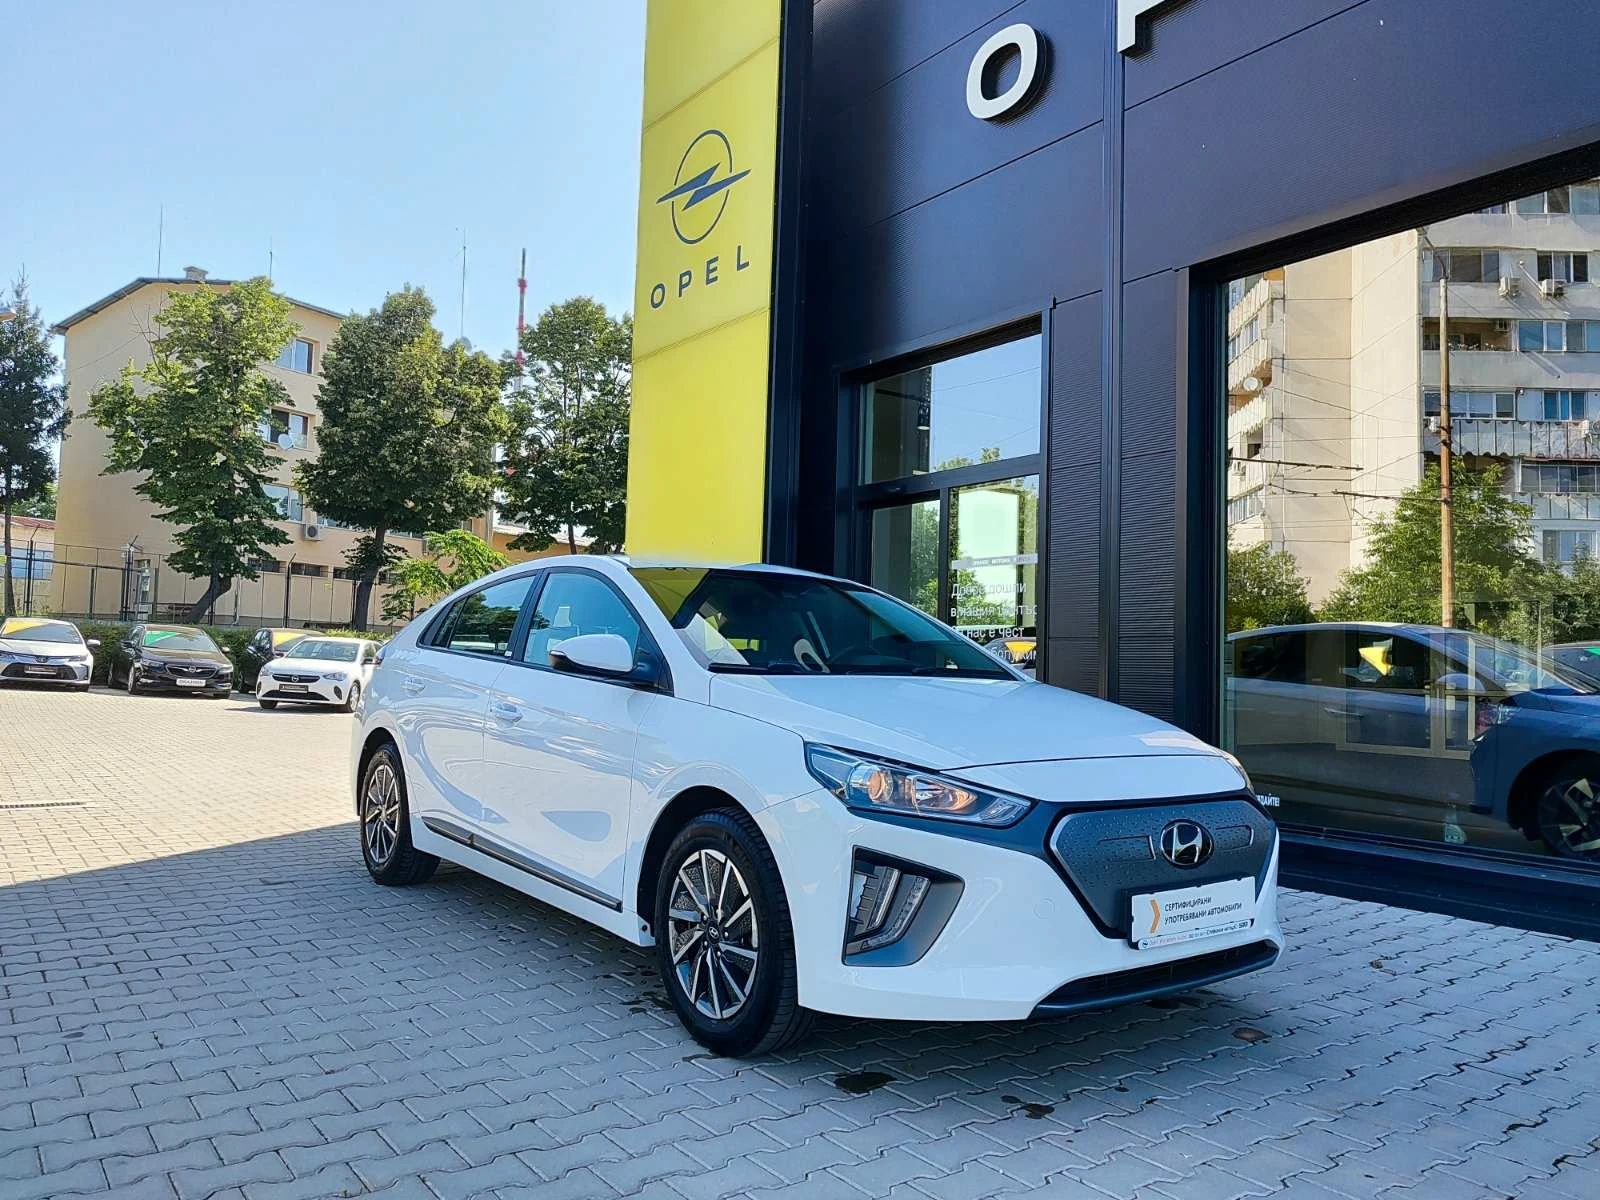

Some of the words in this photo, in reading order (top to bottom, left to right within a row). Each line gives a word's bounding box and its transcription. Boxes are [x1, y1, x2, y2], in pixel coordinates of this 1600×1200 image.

[650, 246, 750, 309] OPEL
[998, 627, 1025, 638] чест
[1164, 896, 1212, 912] СЕРТИФИЦИРАНИ
[1164, 909, 1207, 925] УПОТРЕБЯВАНИ
[1207, 902, 1242, 916] АВТОМОБИЛИ
